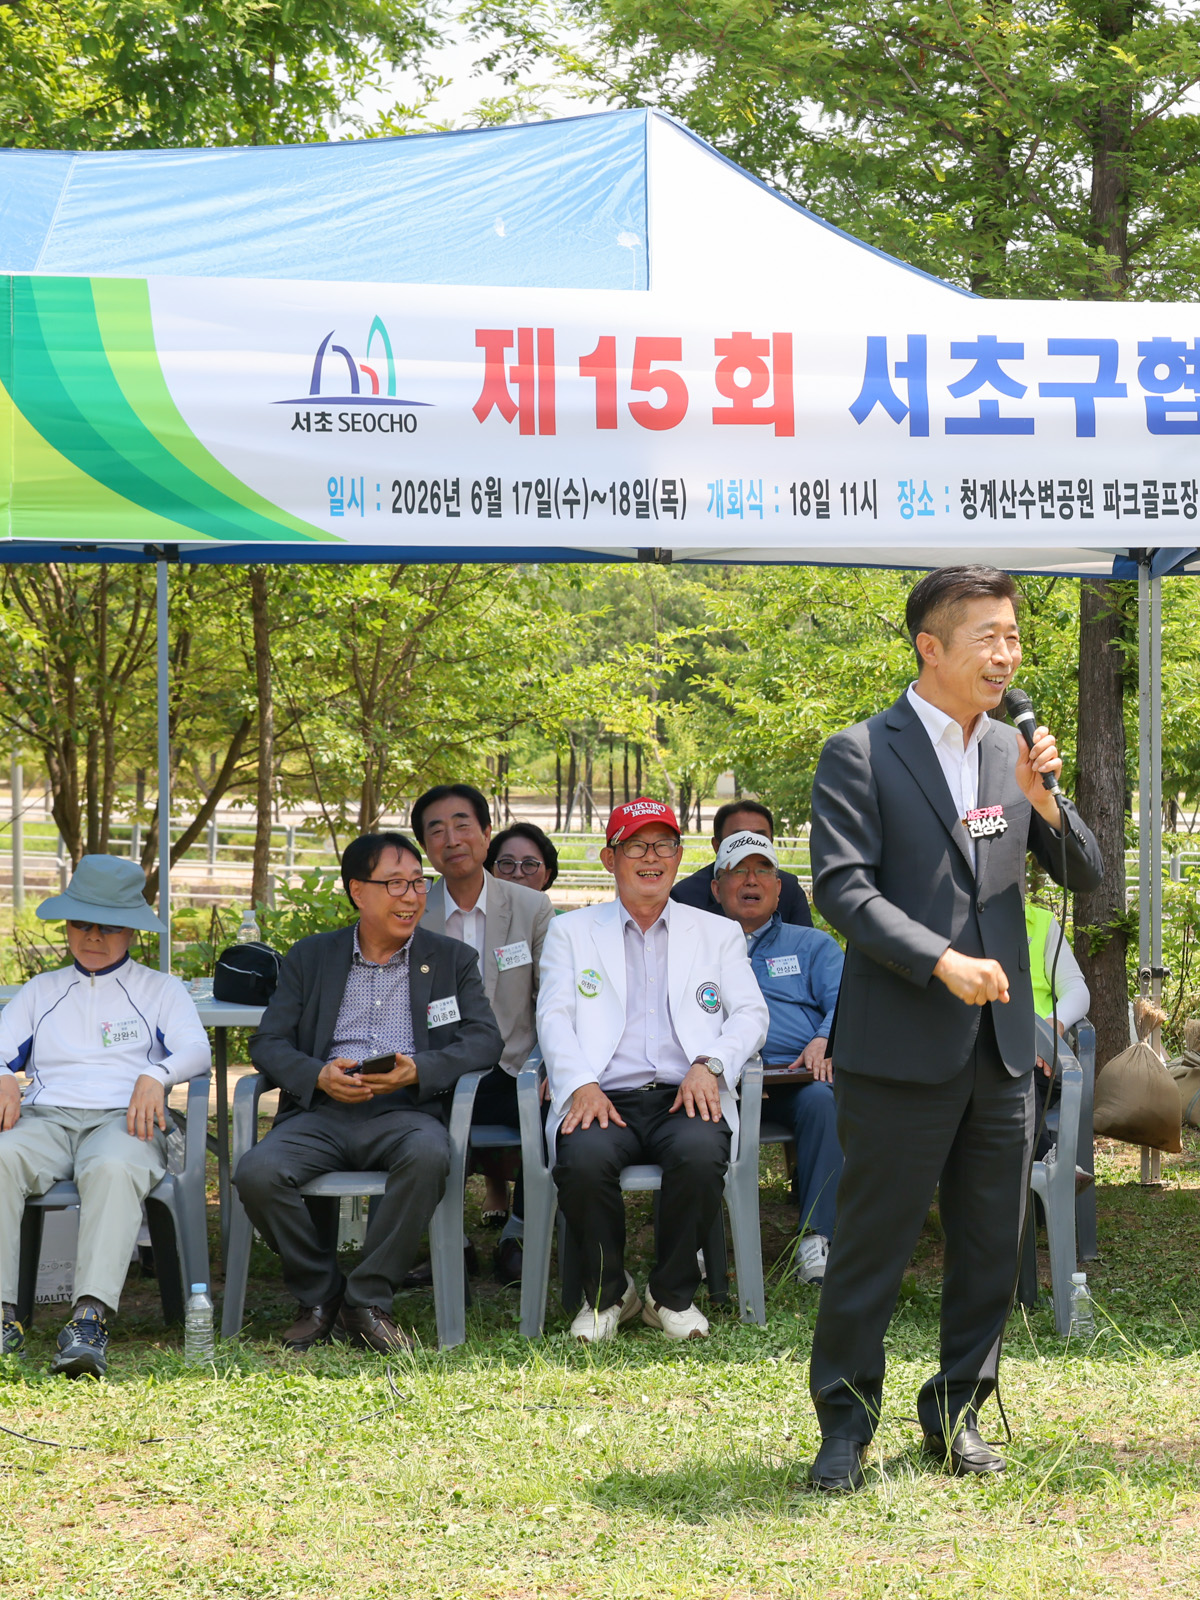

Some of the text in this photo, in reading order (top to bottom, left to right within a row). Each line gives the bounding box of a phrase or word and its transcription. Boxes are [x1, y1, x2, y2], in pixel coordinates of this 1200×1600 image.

[471, 326, 797, 437] 제15회
[290, 411, 418, 434] 서초 SEOCHO
[327, 476, 365, 518] 일시
[391, 477, 461, 518] 2026년
[470, 476, 503, 519] 6월
[512, 477, 687, 521] 17일(수)~18일(목)
[706, 479, 763, 520] 개회식
[789, 478, 831, 520] 18일
[840, 478, 878, 520] 11시
[897, 479, 935, 520] 장소
[959, 478, 1095, 521] 청계산수변공원
[1102, 478, 1199, 520] 파크골프장
[622, 801, 666, 816] BUKURO
[631, 809, 662, 818] HONMA
[967, 816, 1008, 838] 전성수
[726, 835, 768, 854] Titleist
[432, 1009, 457, 1023] 이종환
[112, 1030, 138, 1042] 강완식
[36, 1292, 73, 1303] UALITY
